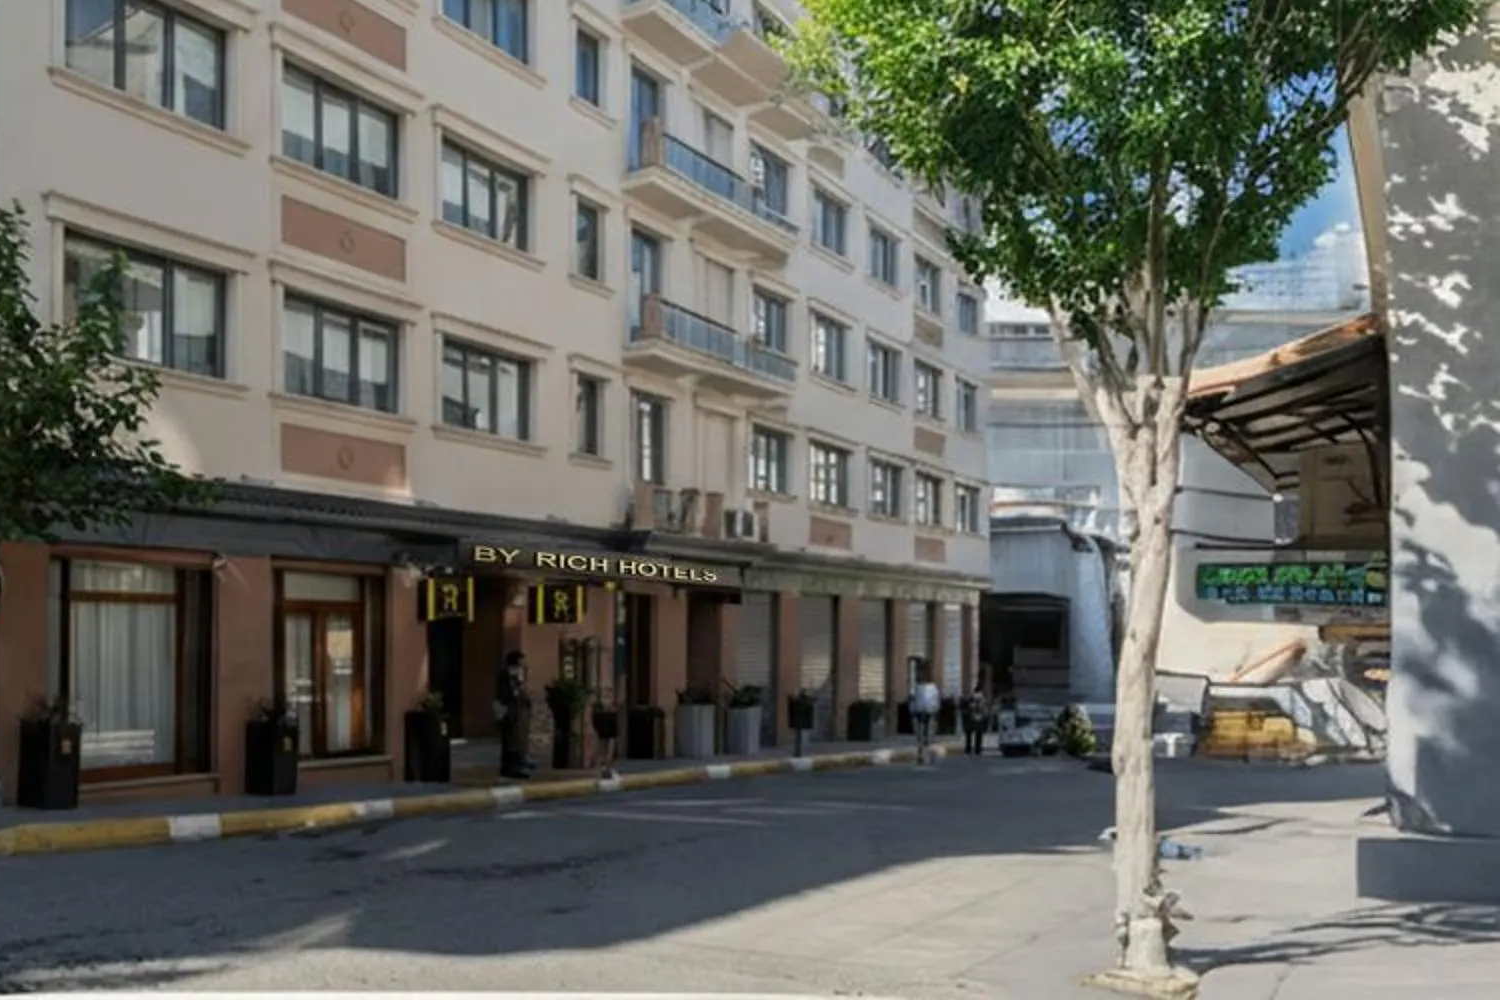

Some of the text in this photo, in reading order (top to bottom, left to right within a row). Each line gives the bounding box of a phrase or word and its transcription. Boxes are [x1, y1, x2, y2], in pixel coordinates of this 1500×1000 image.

[474, 545, 717, 582] BY RICH HOTELS
